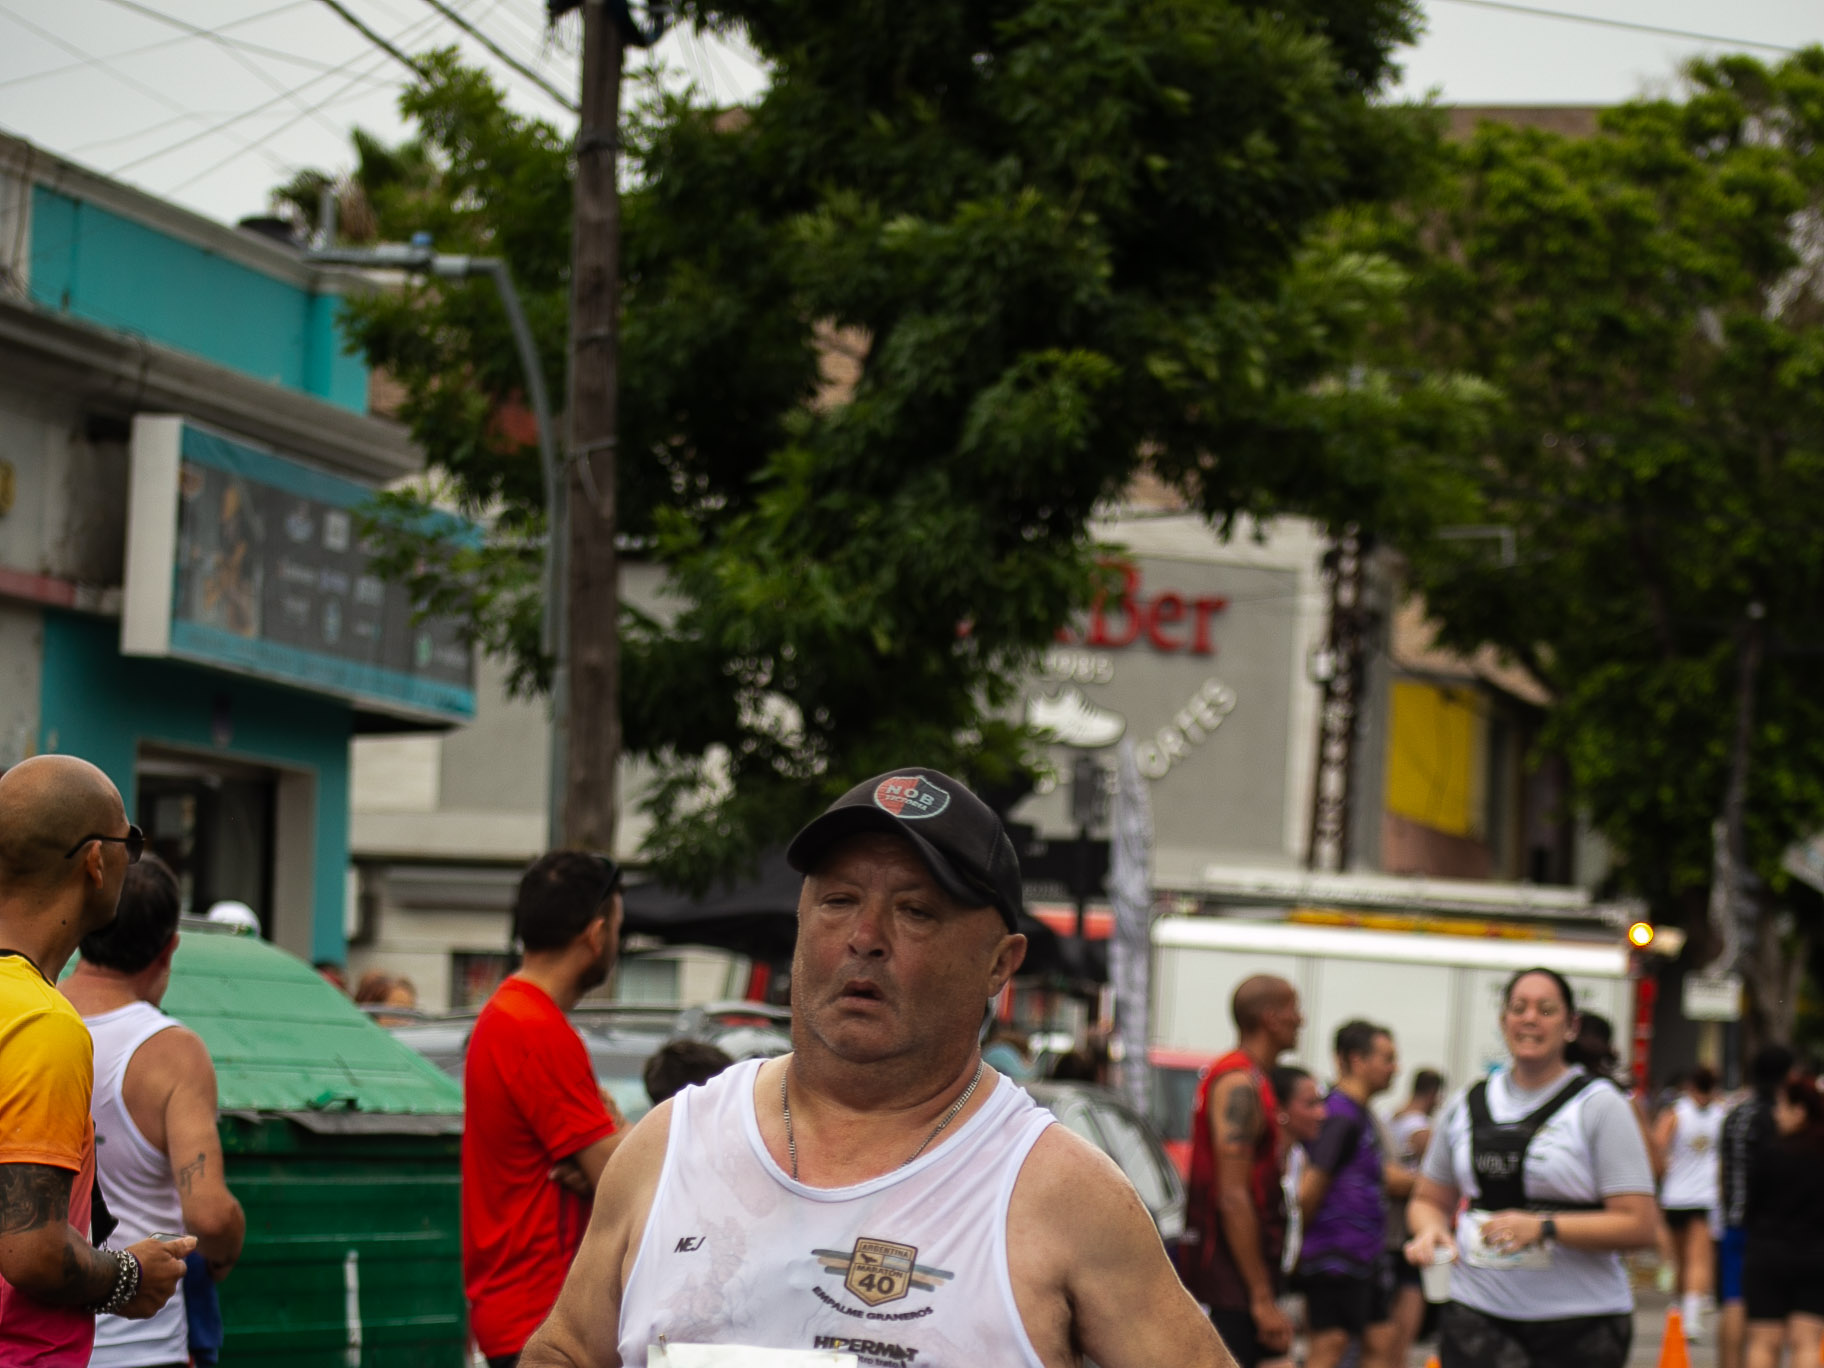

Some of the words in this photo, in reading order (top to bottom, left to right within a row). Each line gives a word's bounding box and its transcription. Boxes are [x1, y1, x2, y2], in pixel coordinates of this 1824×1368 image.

[1053, 558, 1228, 655] Ber
[885, 784, 935, 806] NOB
[861, 1244, 910, 1259] ARGENTINA
[858, 1273, 895, 1295] 40
[811, 1285, 864, 1320] EMPALME
[866, 1306, 934, 1322] GRANEROS
